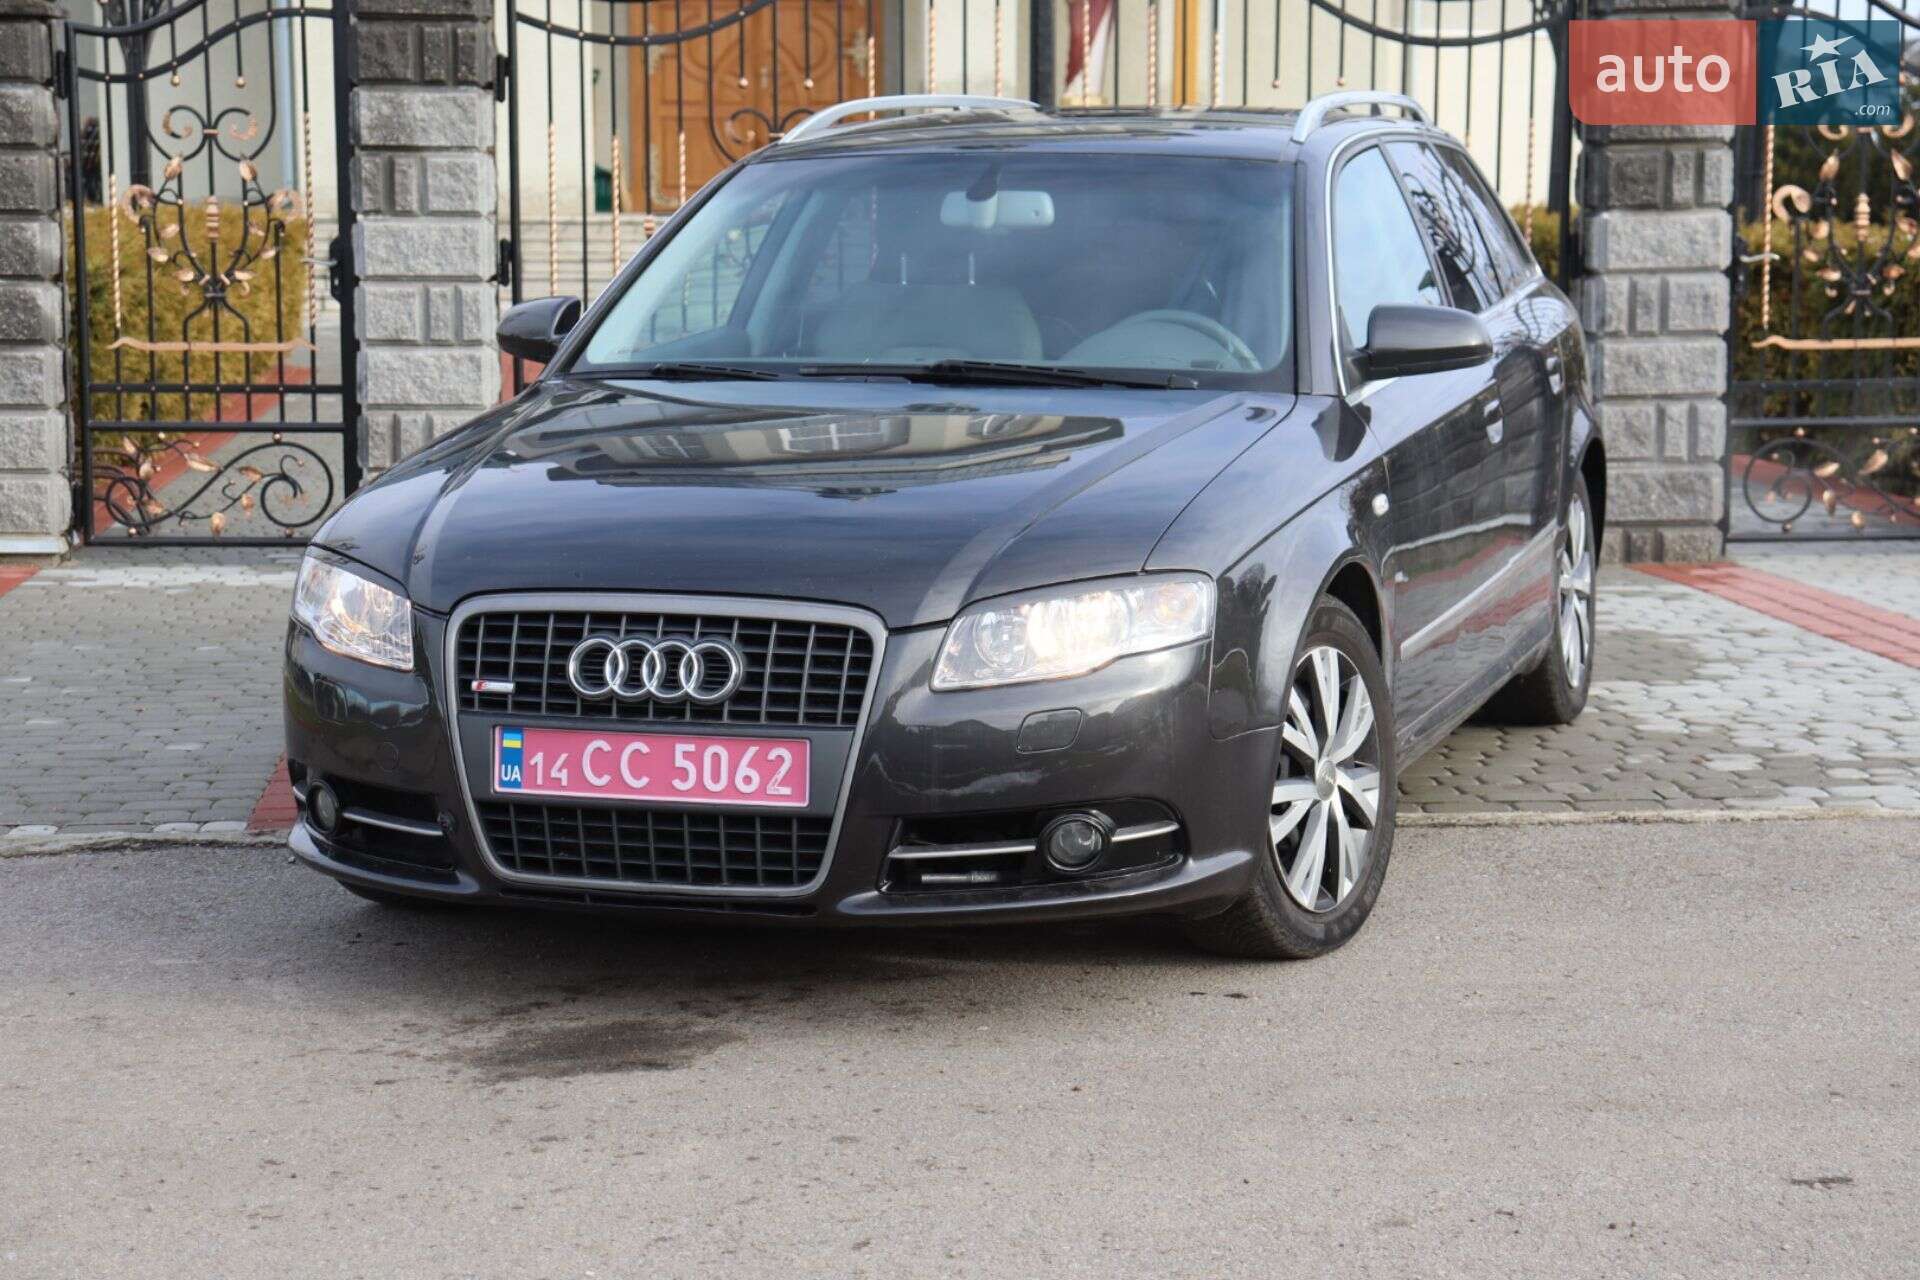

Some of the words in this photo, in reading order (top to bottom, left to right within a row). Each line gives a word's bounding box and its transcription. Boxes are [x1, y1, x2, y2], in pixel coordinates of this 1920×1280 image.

[501, 764, 521, 782] UA
[529, 751, 569, 787] 14
[582, 739, 650, 788] CC
[671, 743, 793, 795] 5062
